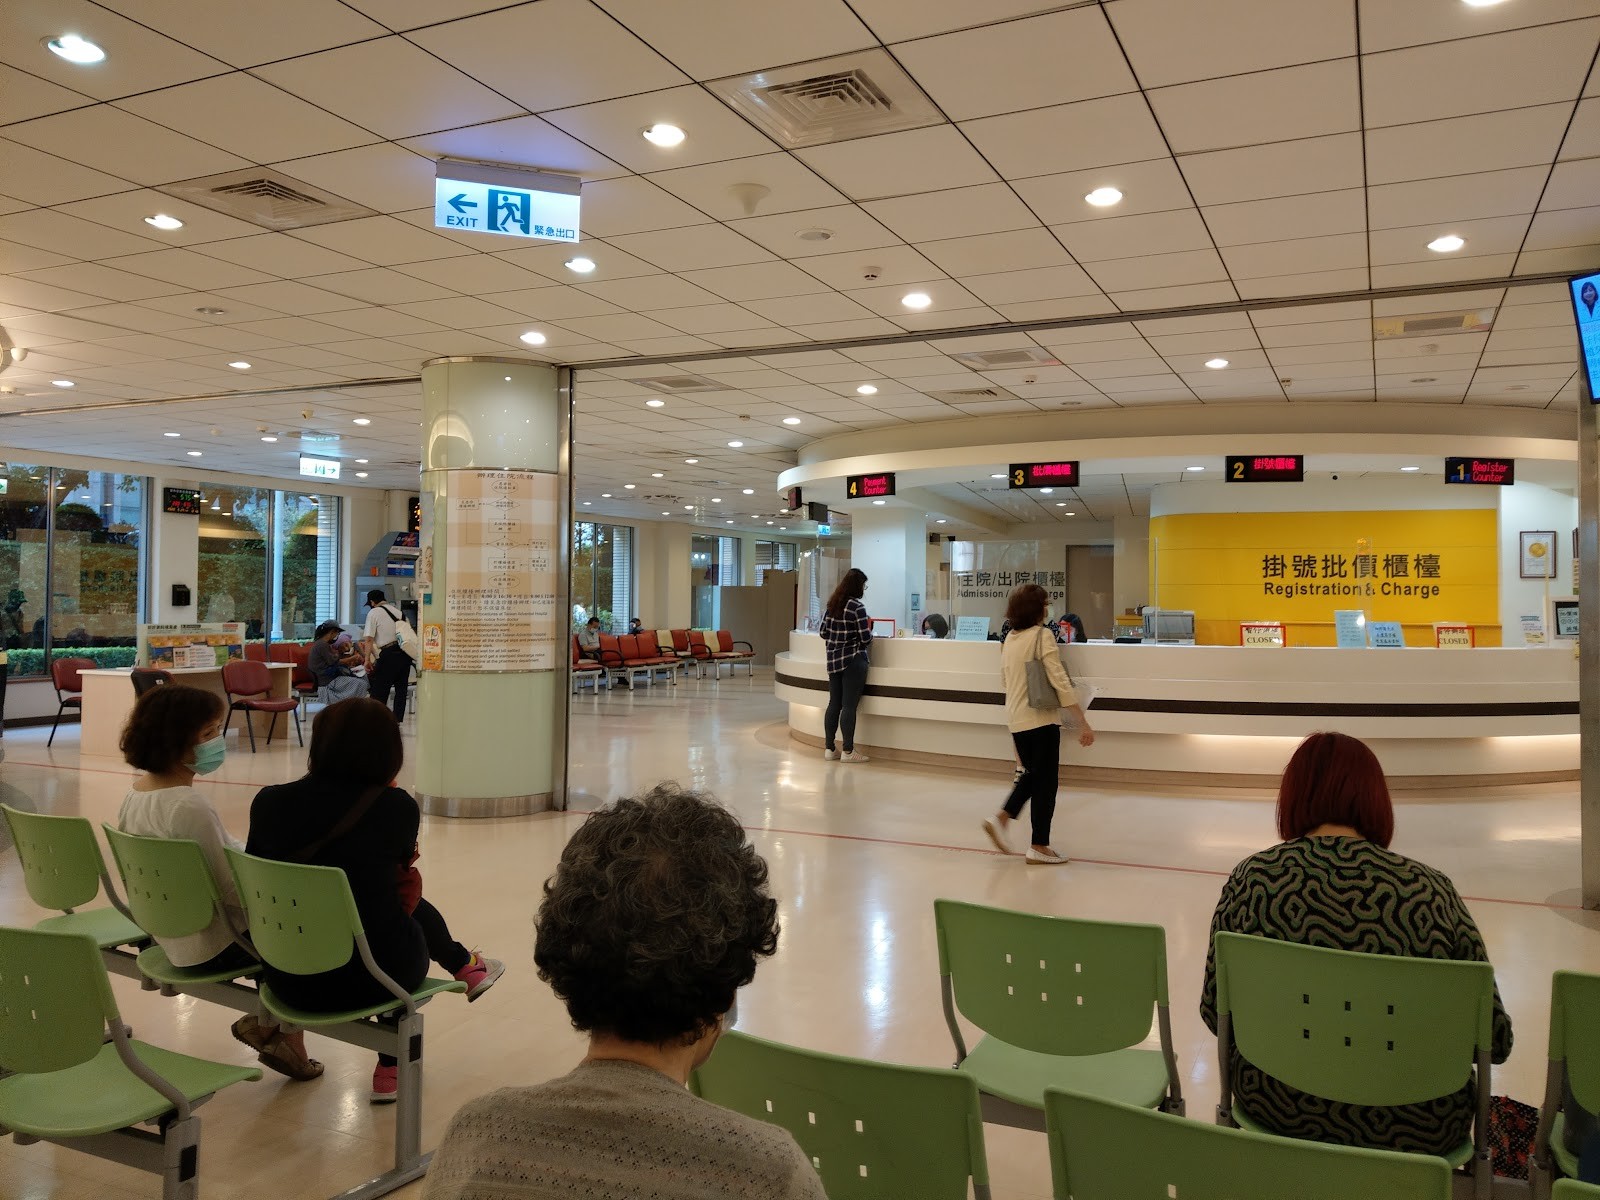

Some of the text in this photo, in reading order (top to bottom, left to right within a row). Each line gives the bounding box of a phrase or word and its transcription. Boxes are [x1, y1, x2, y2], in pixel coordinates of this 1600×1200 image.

[446, 215, 478, 228] EXIT
[534, 224, 575, 239] 緊急出口
[1233, 461, 1245, 479] 2
[1457, 464, 1465, 481] 1
[1472, 460, 1508, 473] Register
[1014, 469, 1025, 486] 3
[1472, 471, 1504, 482] Counter
[849, 481, 858, 496] 4
[863, 486, 887, 495] Counter
[1262, 554, 1441, 579] 掛號批價櫃檯
[957, 589, 1004, 598] Admission
[1264, 582, 1440, 598] Registration & Charge
[1439, 637, 1469, 645] CLOSED
